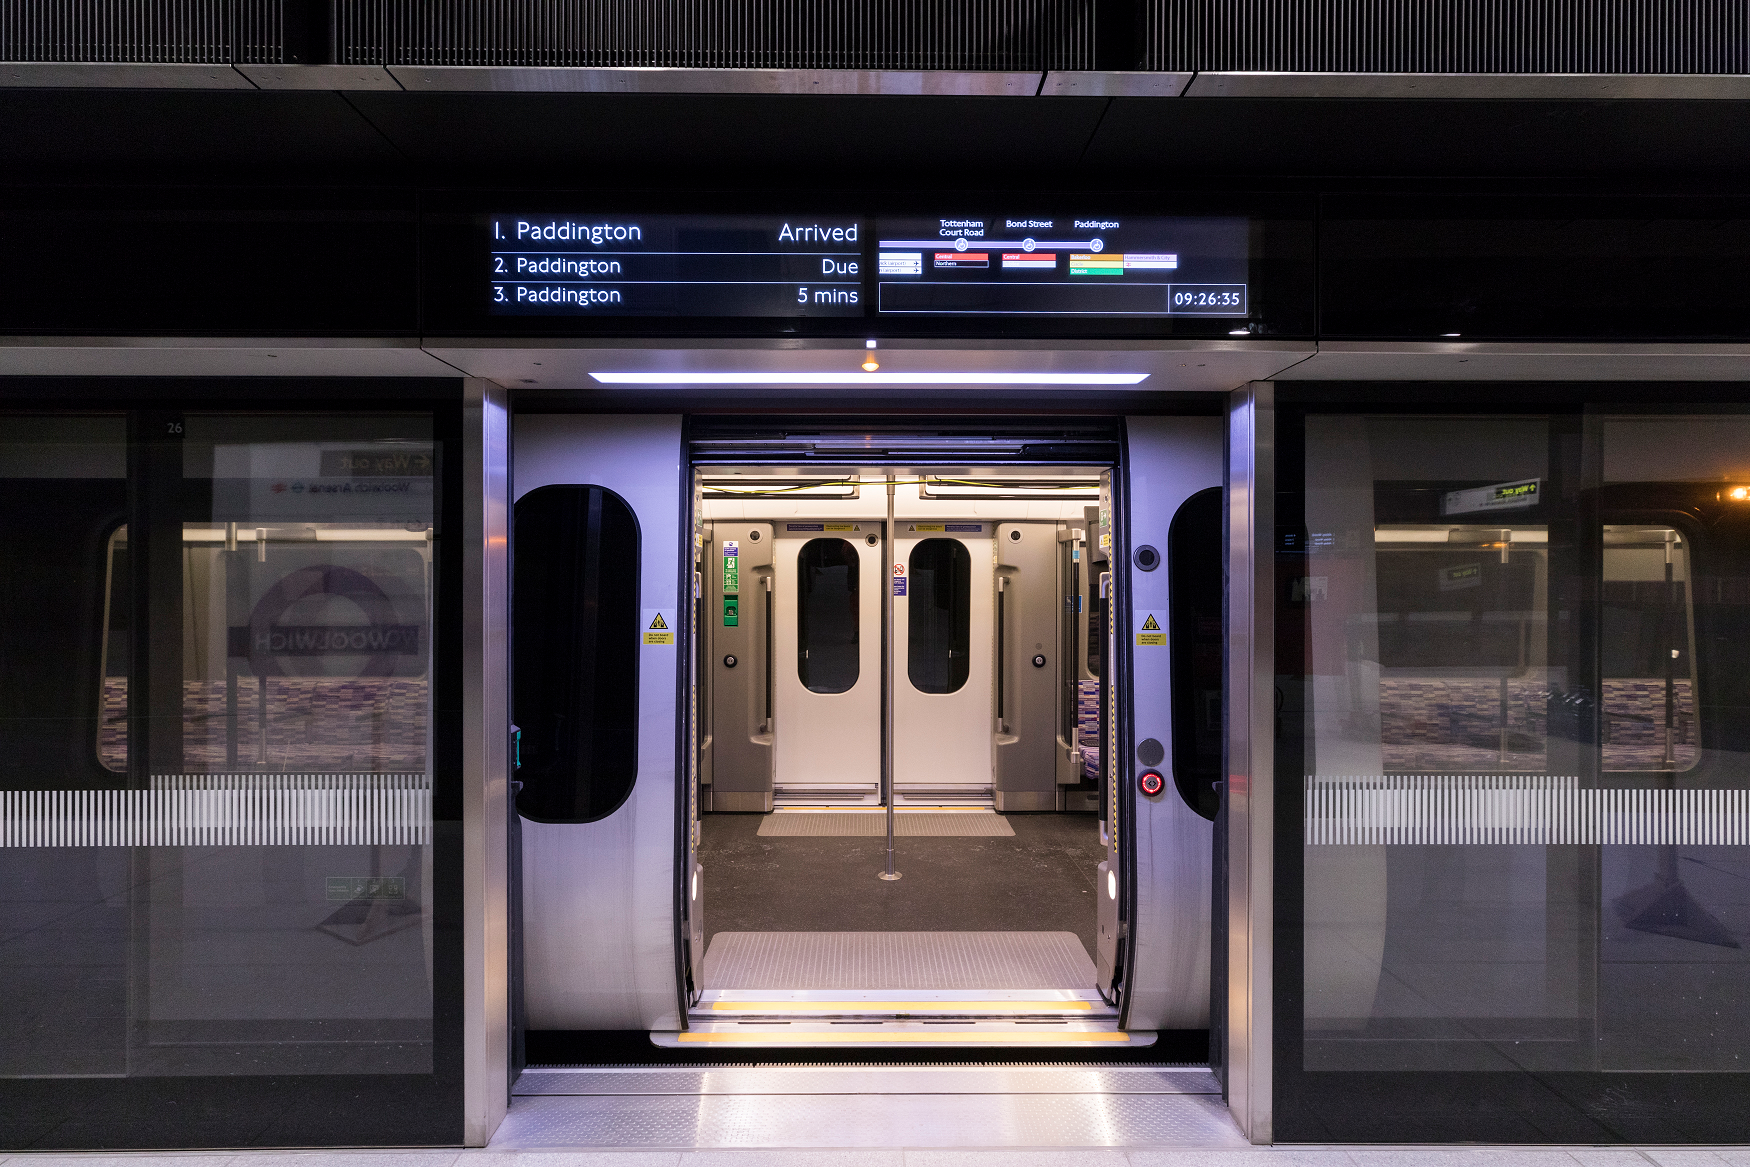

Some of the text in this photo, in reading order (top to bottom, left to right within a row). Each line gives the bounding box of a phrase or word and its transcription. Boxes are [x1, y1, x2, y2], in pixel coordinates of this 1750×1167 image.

[939, 219, 984, 228] Tottenham
[1005, 219, 1053, 229] Bond Street
[1073, 219, 1120, 230] Paddington
[517, 221, 642, 245] Paddington
[777, 222, 858, 242] Arrived
[939, 228, 985, 237] Court Road
[494, 257, 621, 277] 2. Paddington
[822, 258, 859, 275] Due
[493, 286, 621, 307] 3. Paddington
[797, 287, 859, 304] 5 mins
[1173, 291, 1240, 307] 09:26:35
[167, 422, 183, 434] 26
